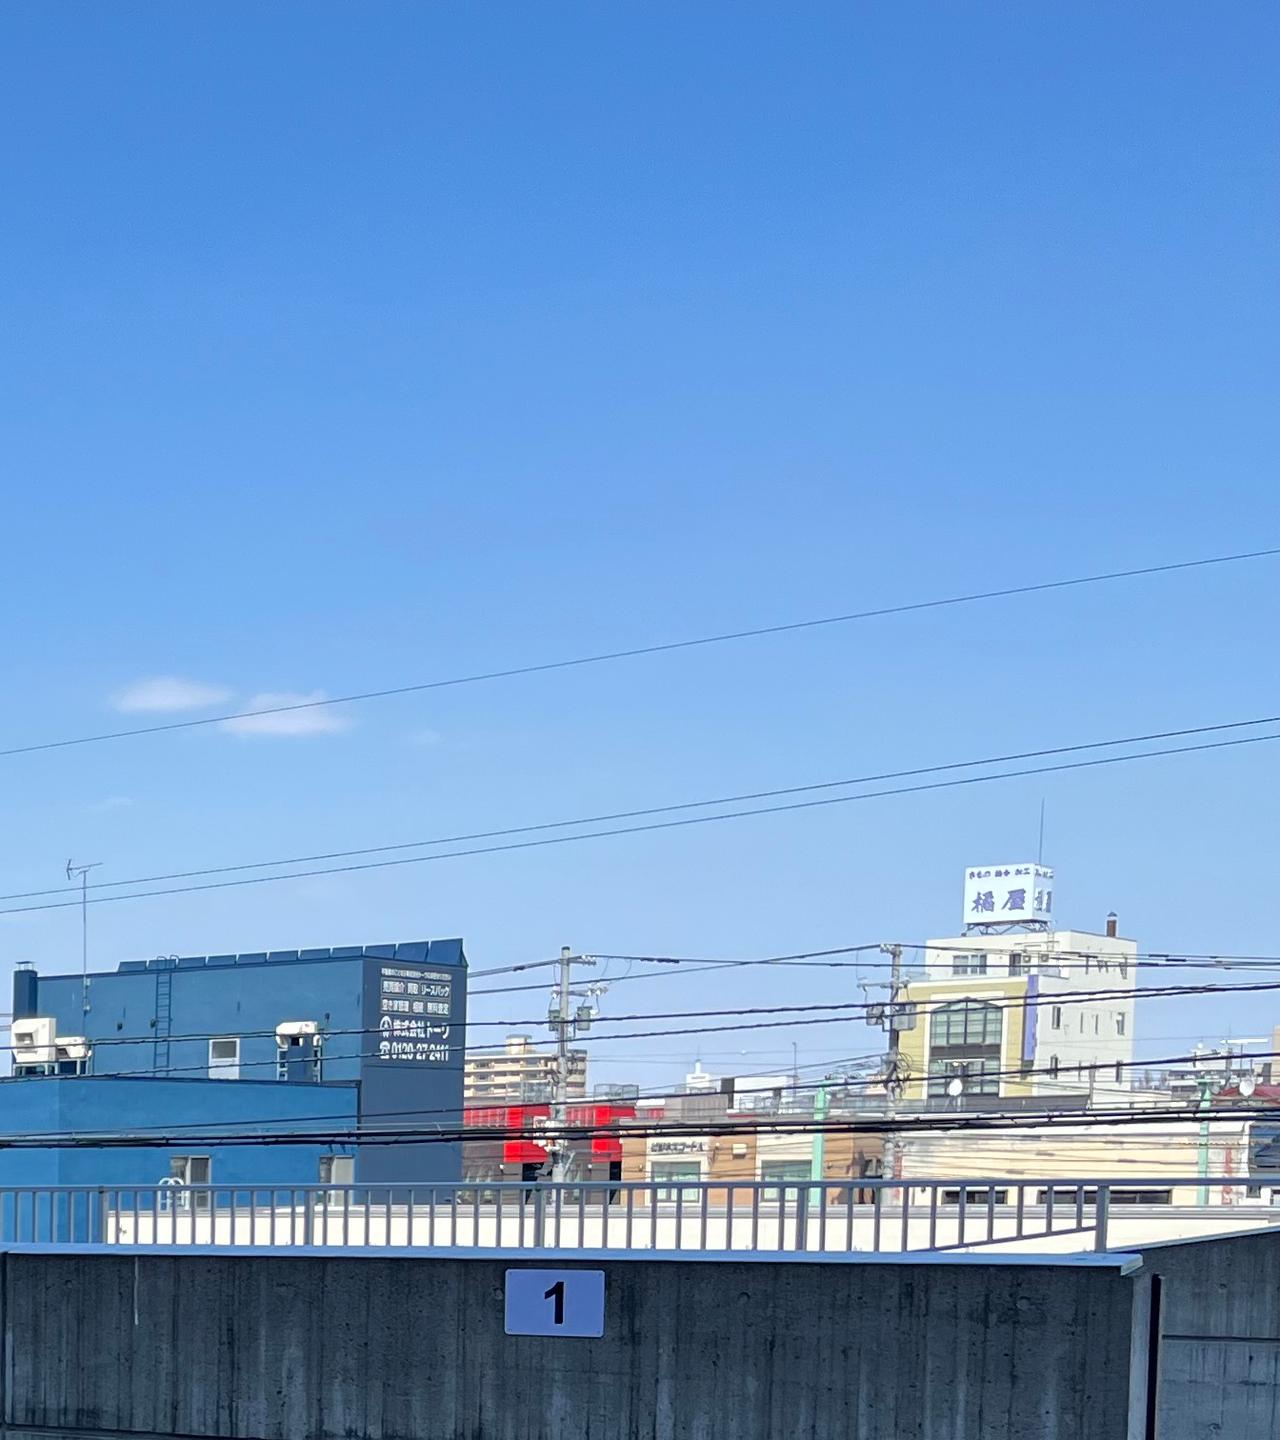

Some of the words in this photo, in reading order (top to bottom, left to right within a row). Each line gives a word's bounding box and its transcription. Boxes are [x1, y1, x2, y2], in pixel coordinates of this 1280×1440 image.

[421, 984, 450, 997] リースバック
[391, 1041, 449, 1062] 0120-27-2411
[544, 1281, 565, 1325] 1
